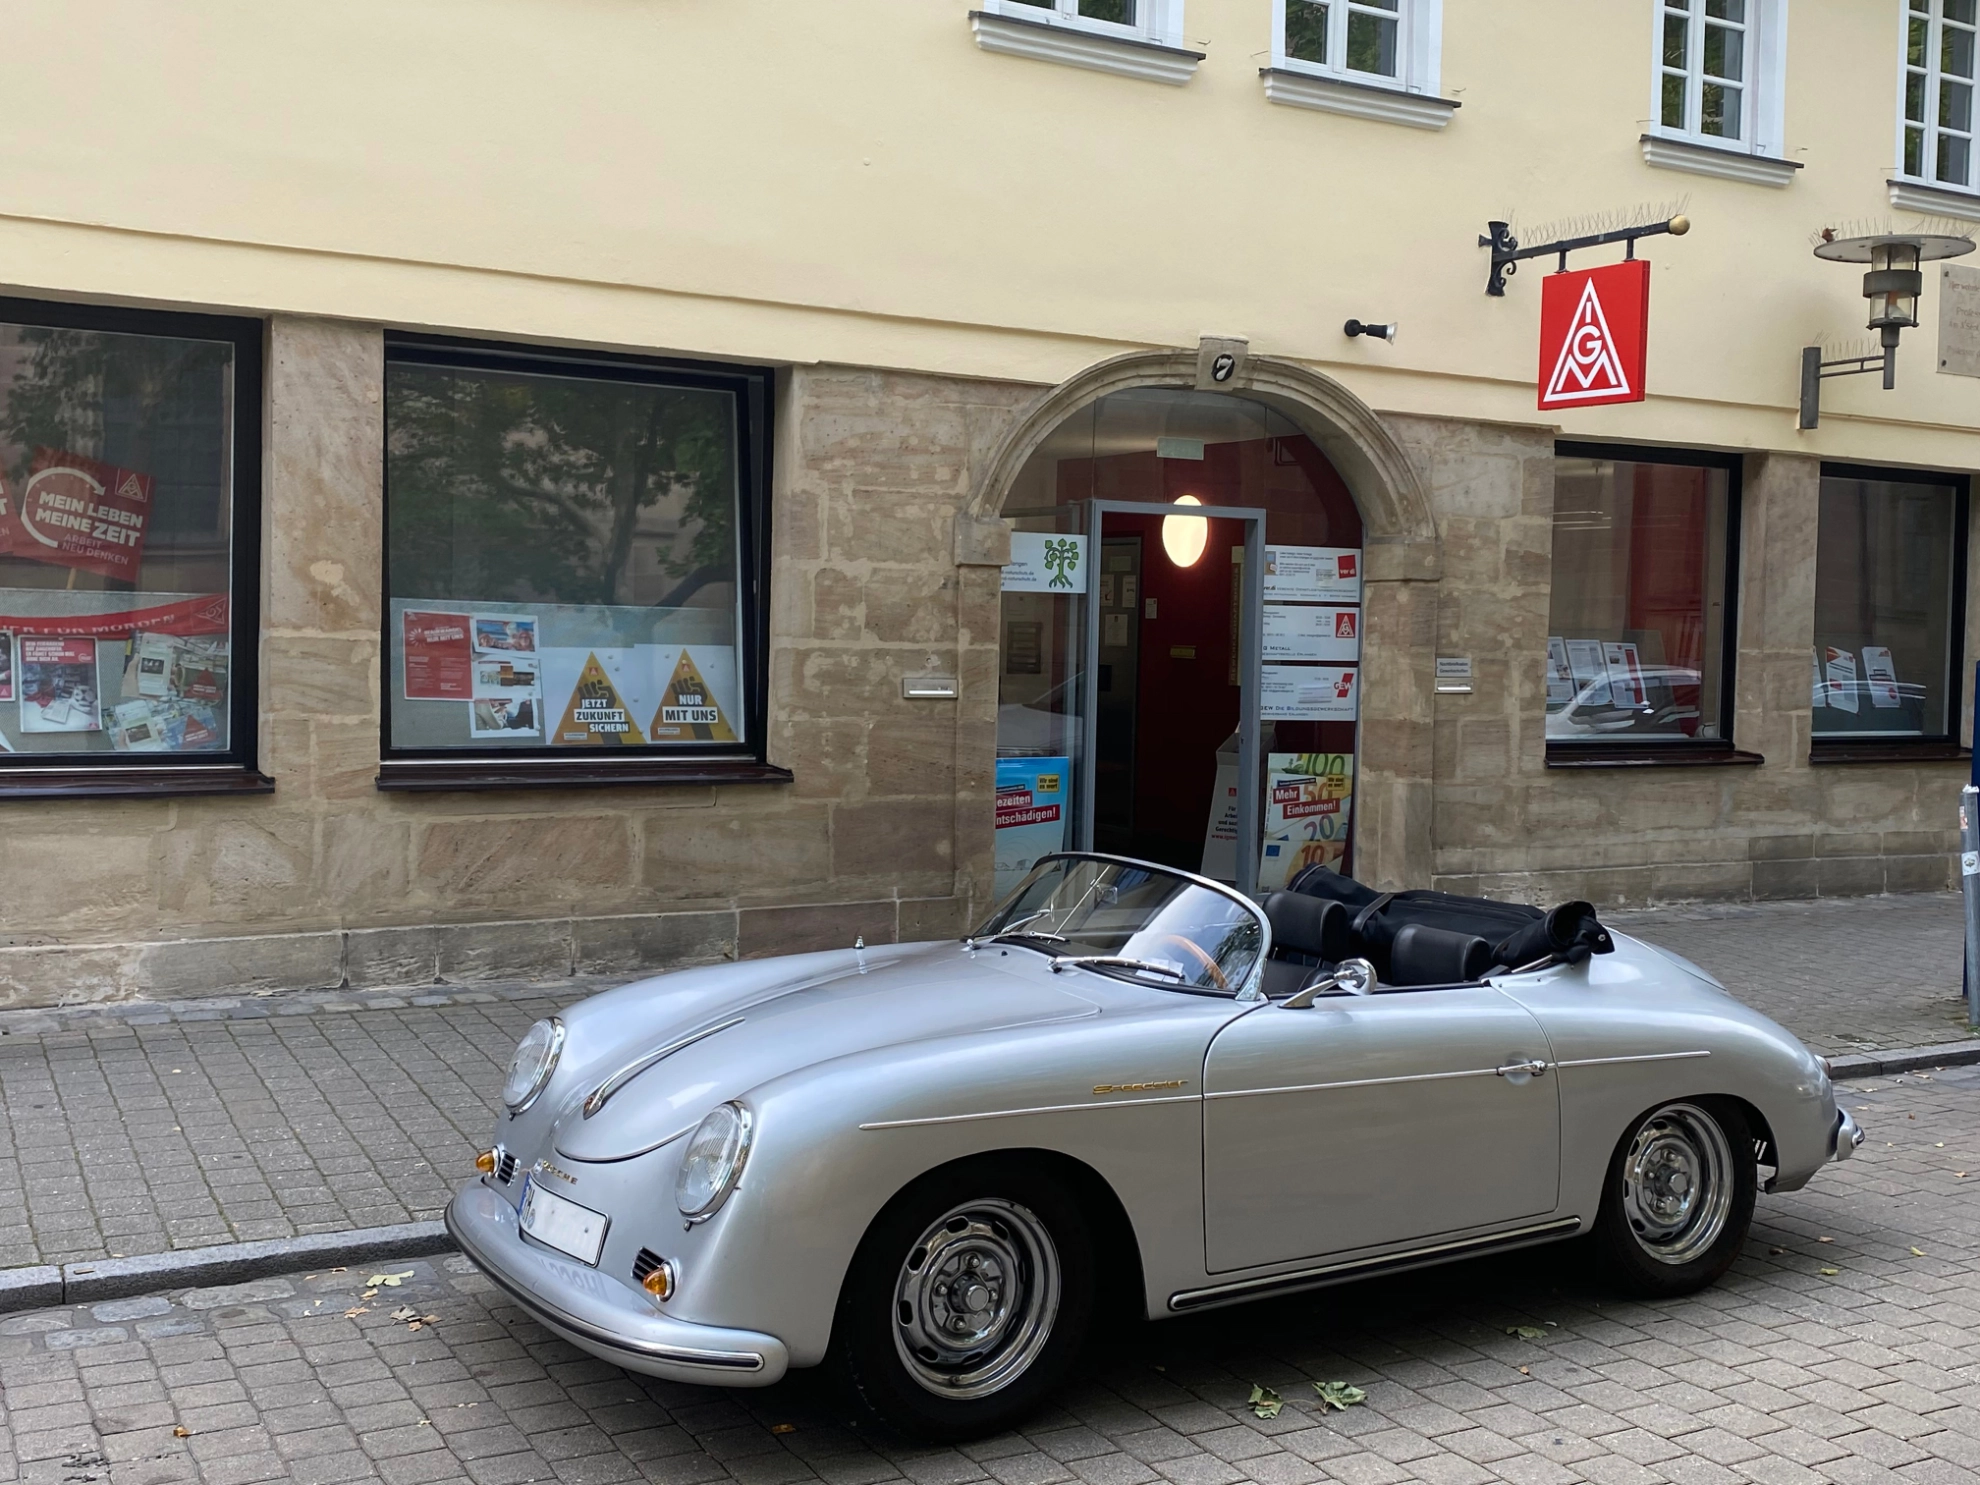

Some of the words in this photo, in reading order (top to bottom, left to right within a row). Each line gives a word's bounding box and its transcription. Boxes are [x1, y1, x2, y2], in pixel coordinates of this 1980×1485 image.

[1216, 357, 1233, 381] 7
[39, 491, 84, 513] MEIN
[87, 503, 143, 528] LEBEN
[35, 508, 92, 533] MEINE
[92, 521, 140, 547] ZEIT
[64, 533, 103, 548] ARBEIT
[62, 542, 85, 554] NEU
[86, 547, 129, 565] DENKEN
[1334, 682, 1353, 690] GEW
[581, 699, 608, 709] JETZT
[679, 694, 703, 705] NUR
[576, 710, 624, 721] ZUKUNFT
[665, 710, 688, 721] MIT
[692, 710, 717, 721] UNS
[589, 723, 629, 732] SICHERN
[997, 795, 1031, 808] ezeiten
[1275, 789, 1298, 800] Mehr
[1287, 800, 1336, 816] Einkommen!
[996, 807, 1056, 826] ntschädigen!
[1303, 814, 1335, 840] 20
[1301, 845, 1325, 868] 10
